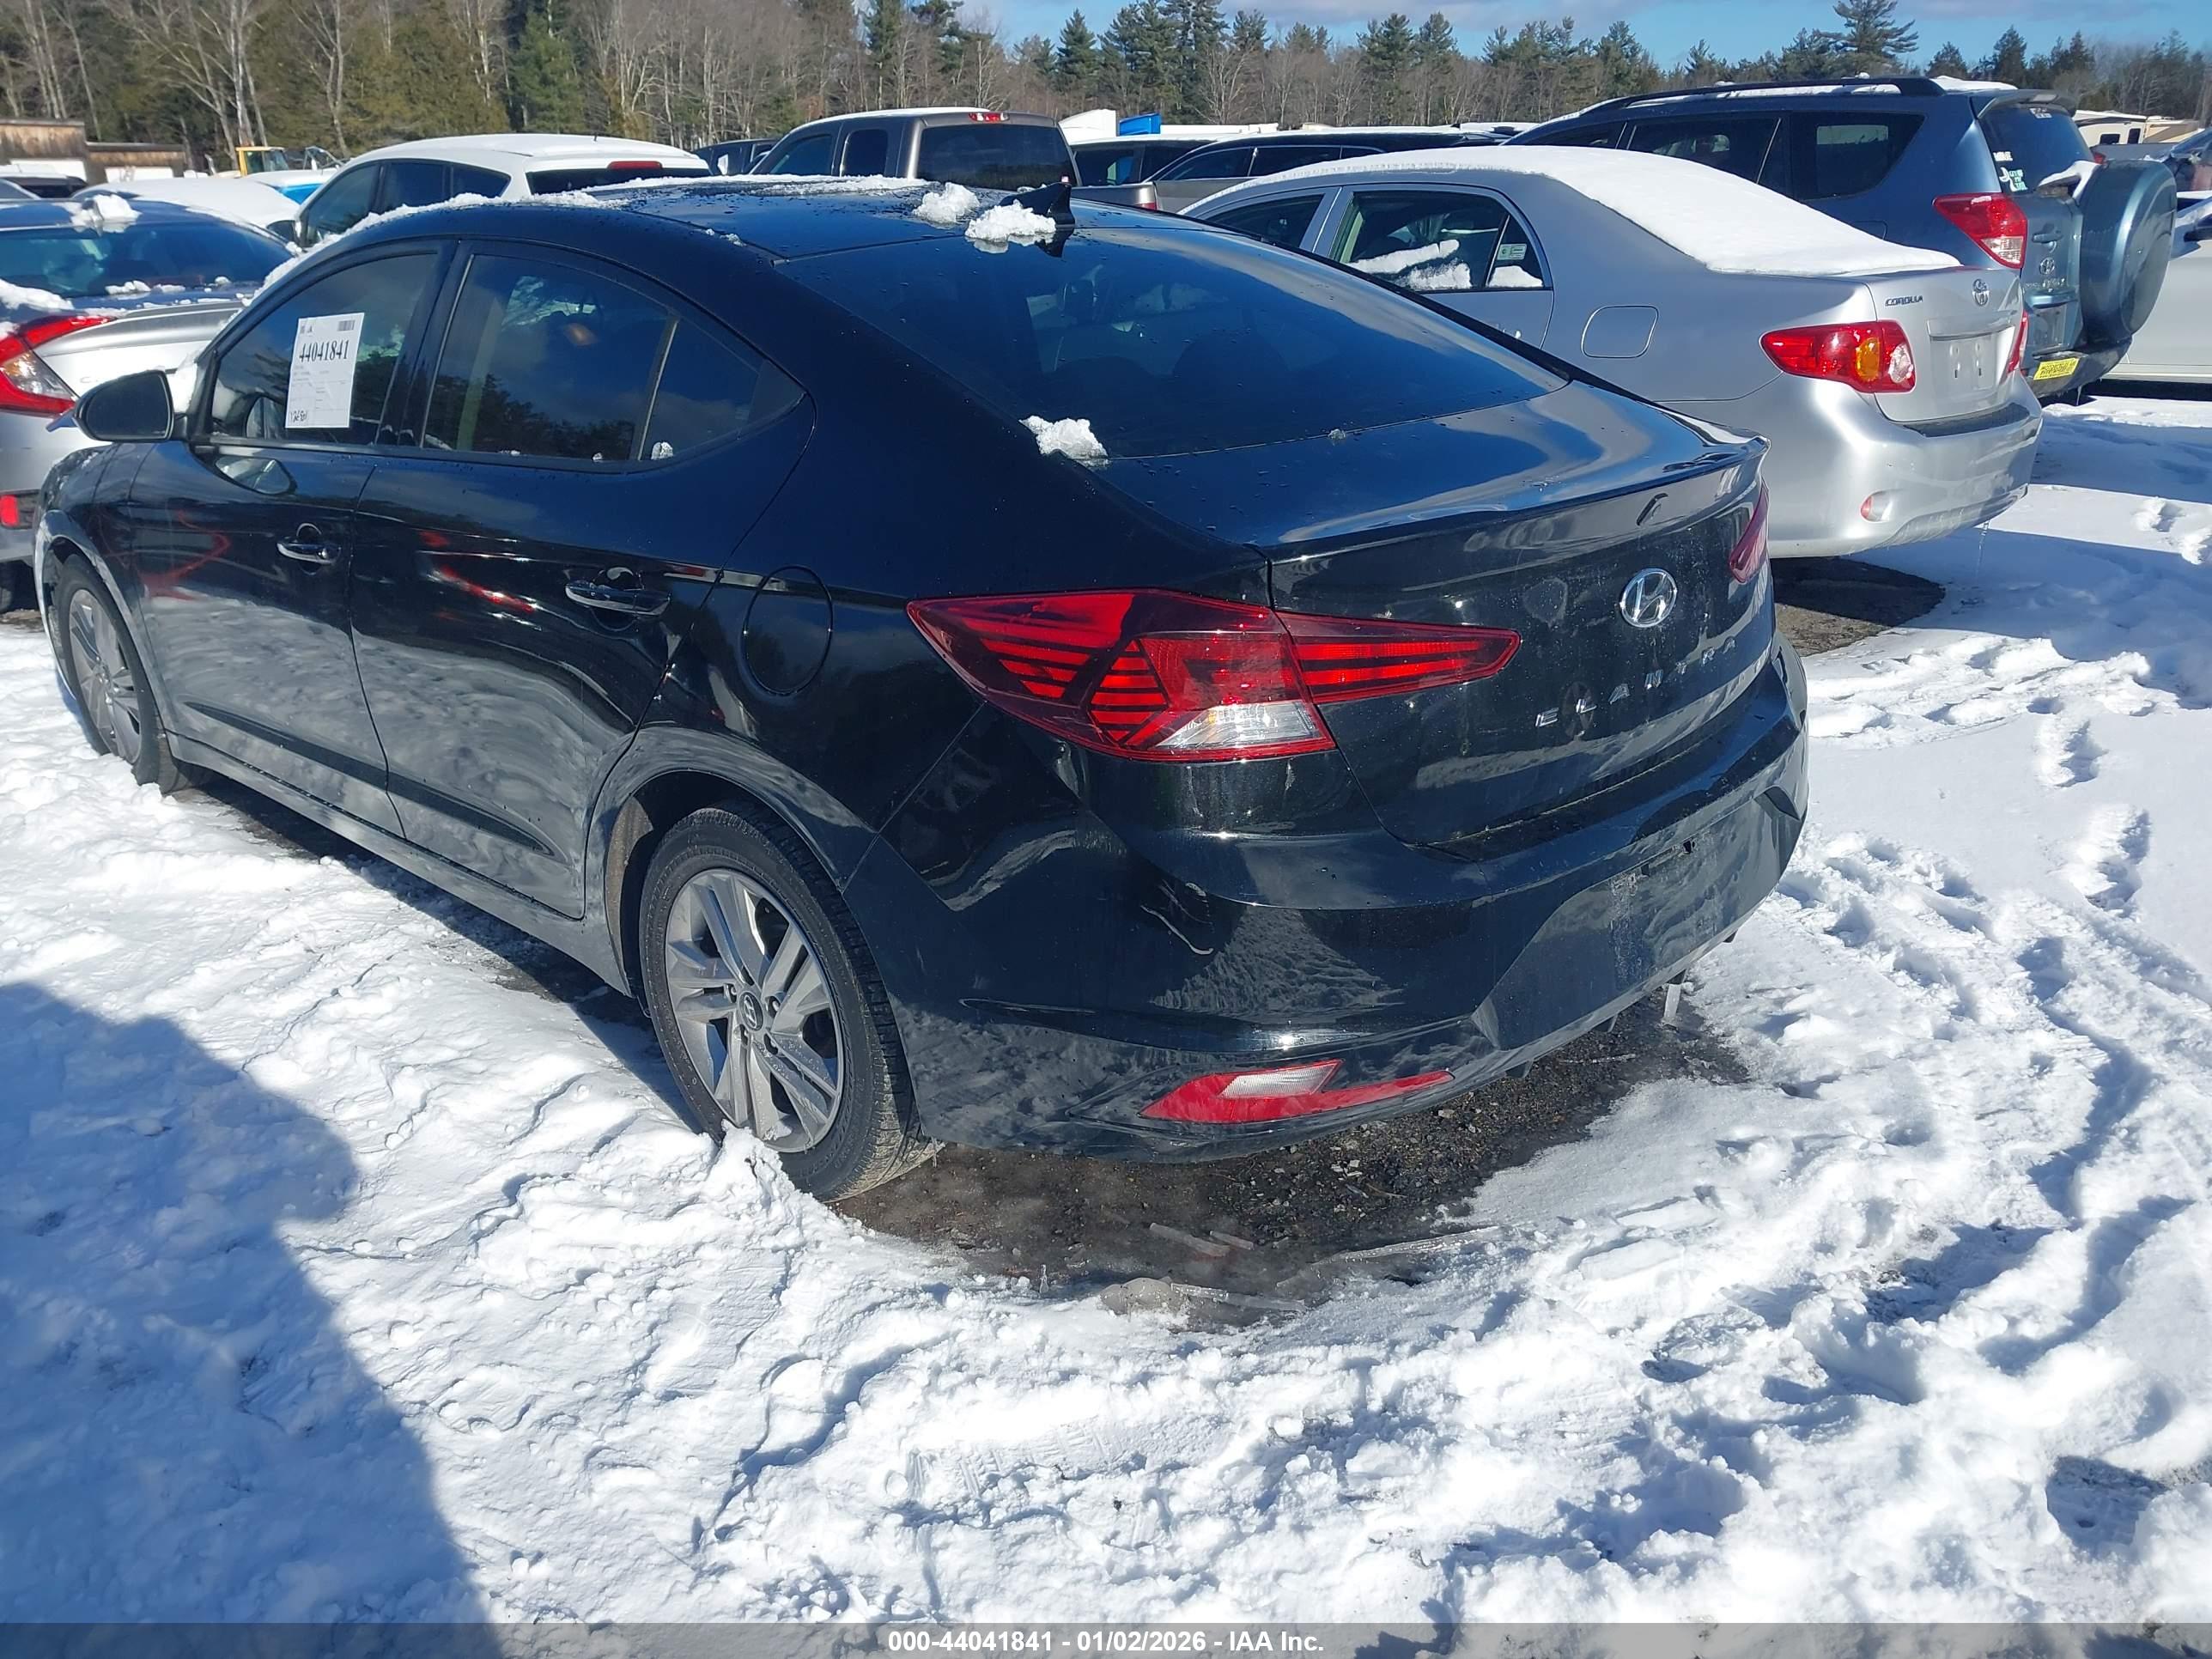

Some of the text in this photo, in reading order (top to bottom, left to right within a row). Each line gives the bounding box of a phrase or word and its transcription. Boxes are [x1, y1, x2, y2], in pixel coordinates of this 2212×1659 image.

[1884, 295, 1923, 307] COROLLA
[299, 339, 349, 362] 44041841
[1534, 635, 1736, 728] ELANTRA
